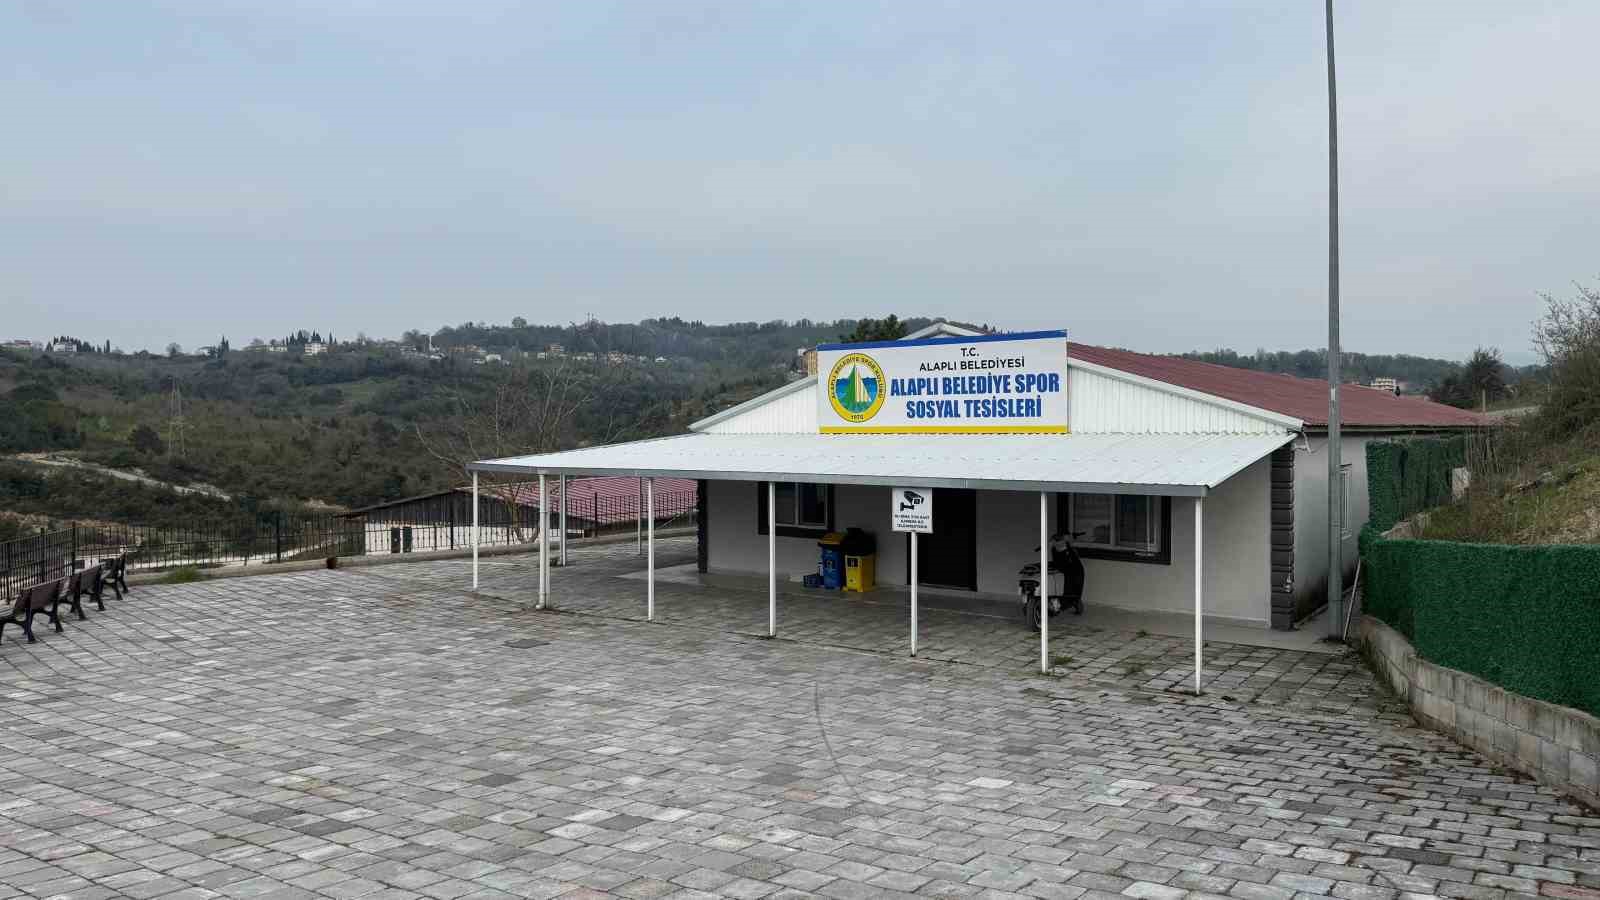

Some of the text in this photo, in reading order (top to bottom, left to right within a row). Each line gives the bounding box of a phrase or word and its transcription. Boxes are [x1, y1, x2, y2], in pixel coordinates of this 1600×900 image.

[960, 347, 980, 357] T.C.
[919, 356, 1025, 372] ALAPLI BELEDİYESİ
[890, 372, 1060, 396] ALAPLI BELEDİYE SPOR
[906, 394, 1042, 419] SOSYAL TESİSLERİ
